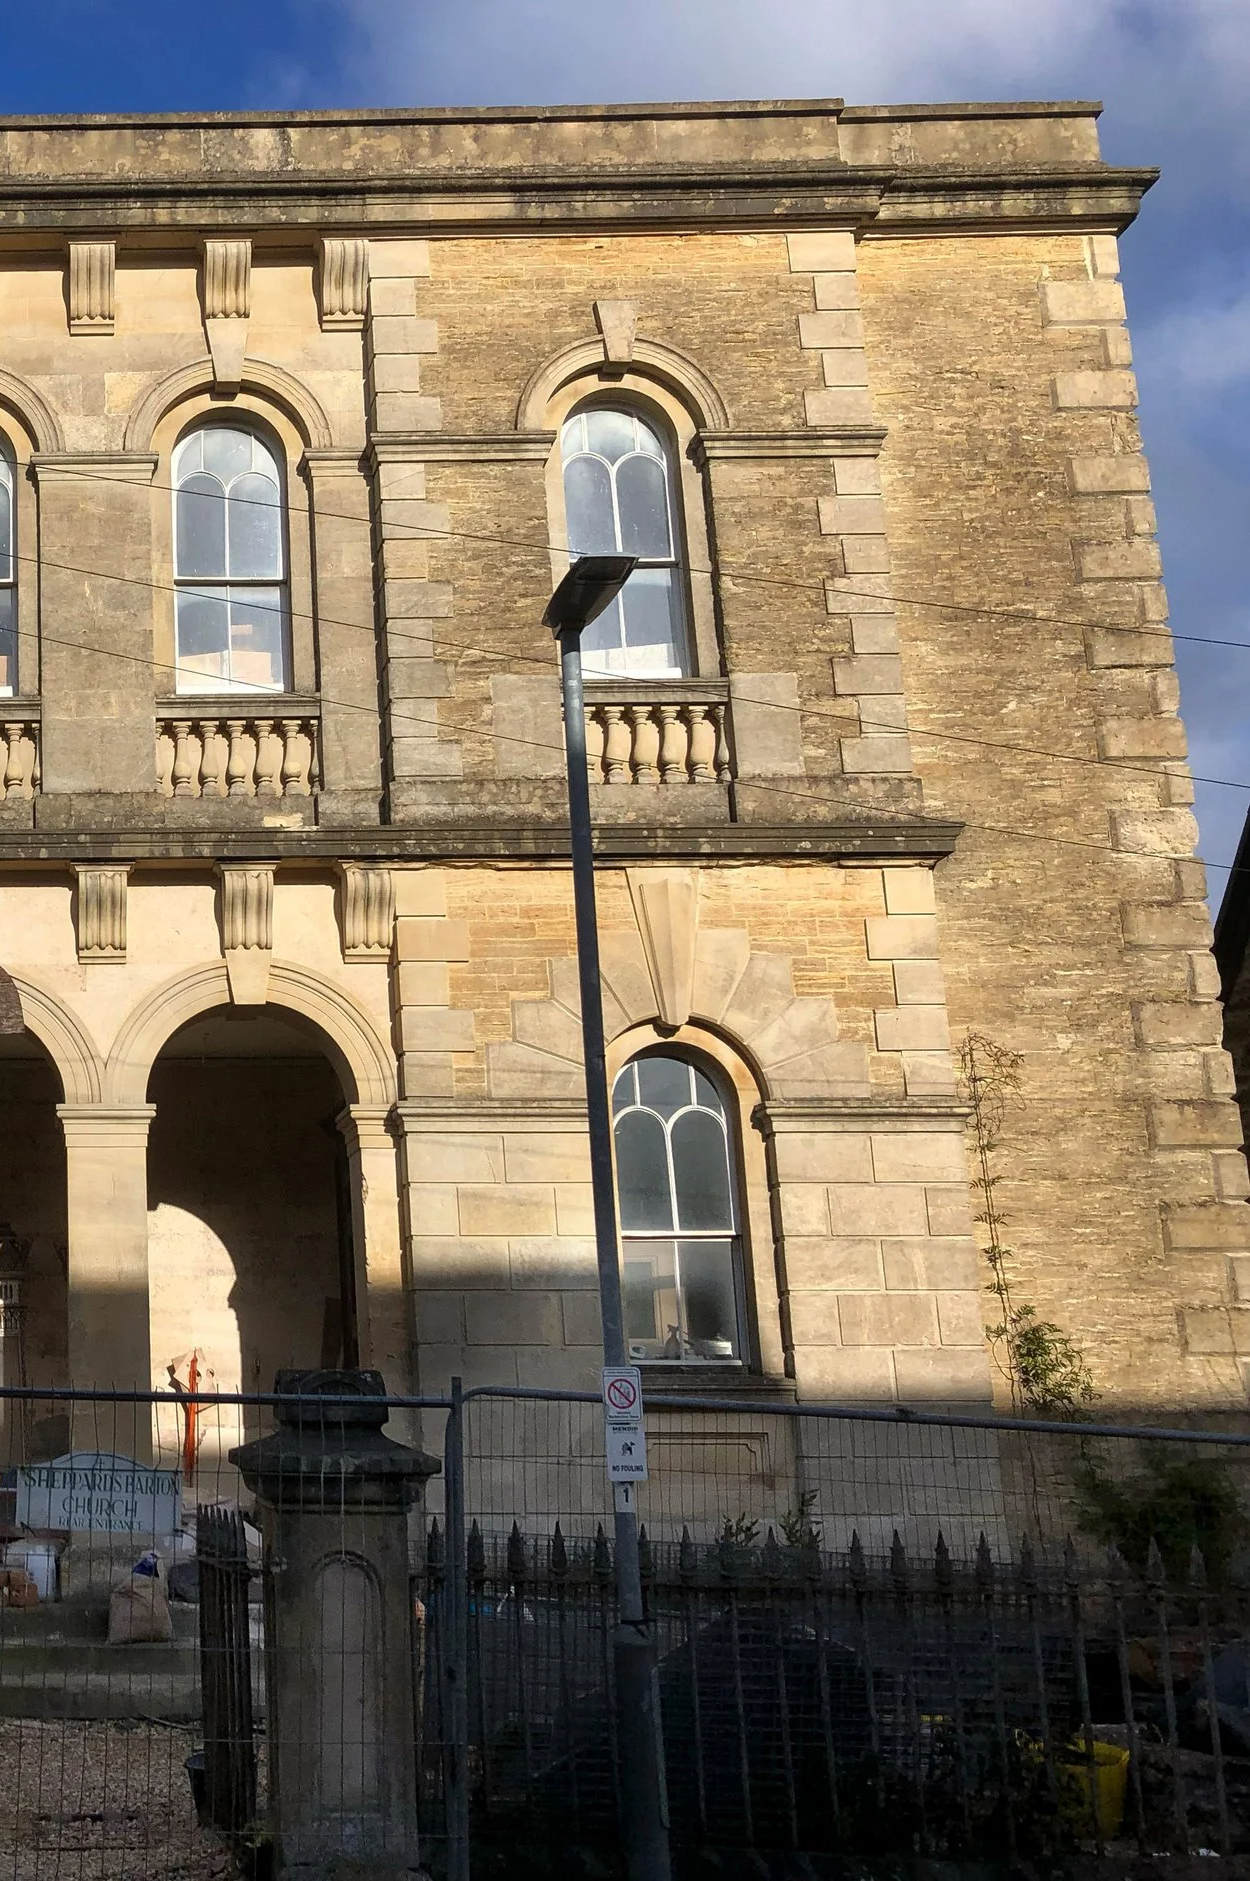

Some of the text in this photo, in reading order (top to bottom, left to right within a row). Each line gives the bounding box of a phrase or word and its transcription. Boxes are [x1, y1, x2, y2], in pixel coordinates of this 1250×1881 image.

[24, 1469, 180, 1496] SHEPPARDS BARTON
[623, 1486, 629, 1503] 1
[62, 1496, 138, 1518] CHURCH
